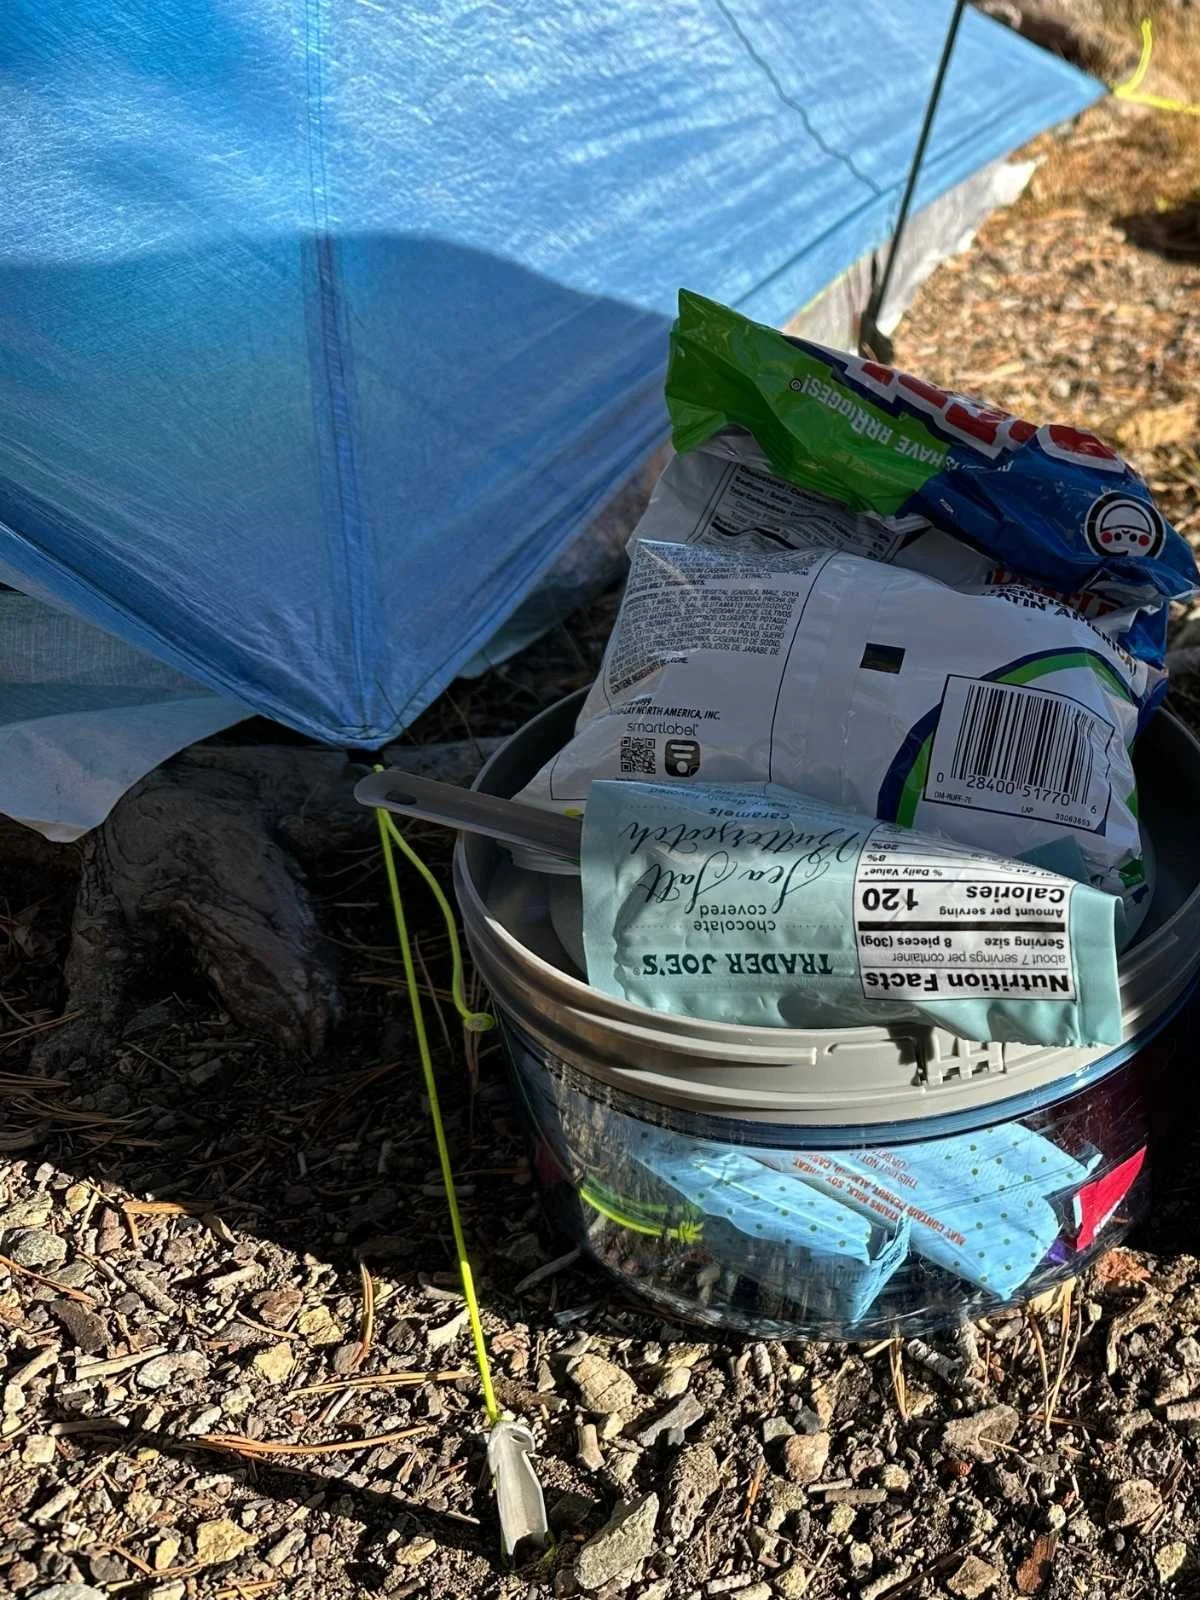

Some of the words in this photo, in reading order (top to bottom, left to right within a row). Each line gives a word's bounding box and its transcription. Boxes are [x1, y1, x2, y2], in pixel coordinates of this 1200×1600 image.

[898, 434, 945, 464] HAVE
[704, 709, 720, 720] INC.
[966, 774, 1015, 795] 28400
[1022, 785, 1070, 807] 51770
[707, 807, 790, 821] caramels
[618, 821, 860, 865] Butterscotch
[902, 867, 930, 876] Daily
[629, 851, 737, 914] Salt
[740, 853, 831, 914] Sea
[862, 887, 919, 911] 120
[965, 885, 1066, 903] Calories
[699, 903, 767, 918] covered
[939, 905, 986, 917] serving
[990, 905, 1011, 917] per
[1015, 908, 1064, 918] Amount
[692, 920, 776, 934] chocolate
[860, 935, 894, 948] (30g)
[896, 935, 941, 947] pieces
[943, 937, 952, 948] 8
[984, 937, 1010, 948] size
[1014, 936, 1065, 949] Serving
[892, 953, 945, 964] container
[947, 951, 967, 962] per
[968, 951, 1018, 964] servings
[1021, 953, 1030, 965] 7
[1032, 953, 1066, 965] about
[642, 953, 718, 976] JOE'S
[725, 953, 833, 975] TRADER
[864, 972, 938, 992] Facts
[948, 973, 1070, 992] Nutrition
